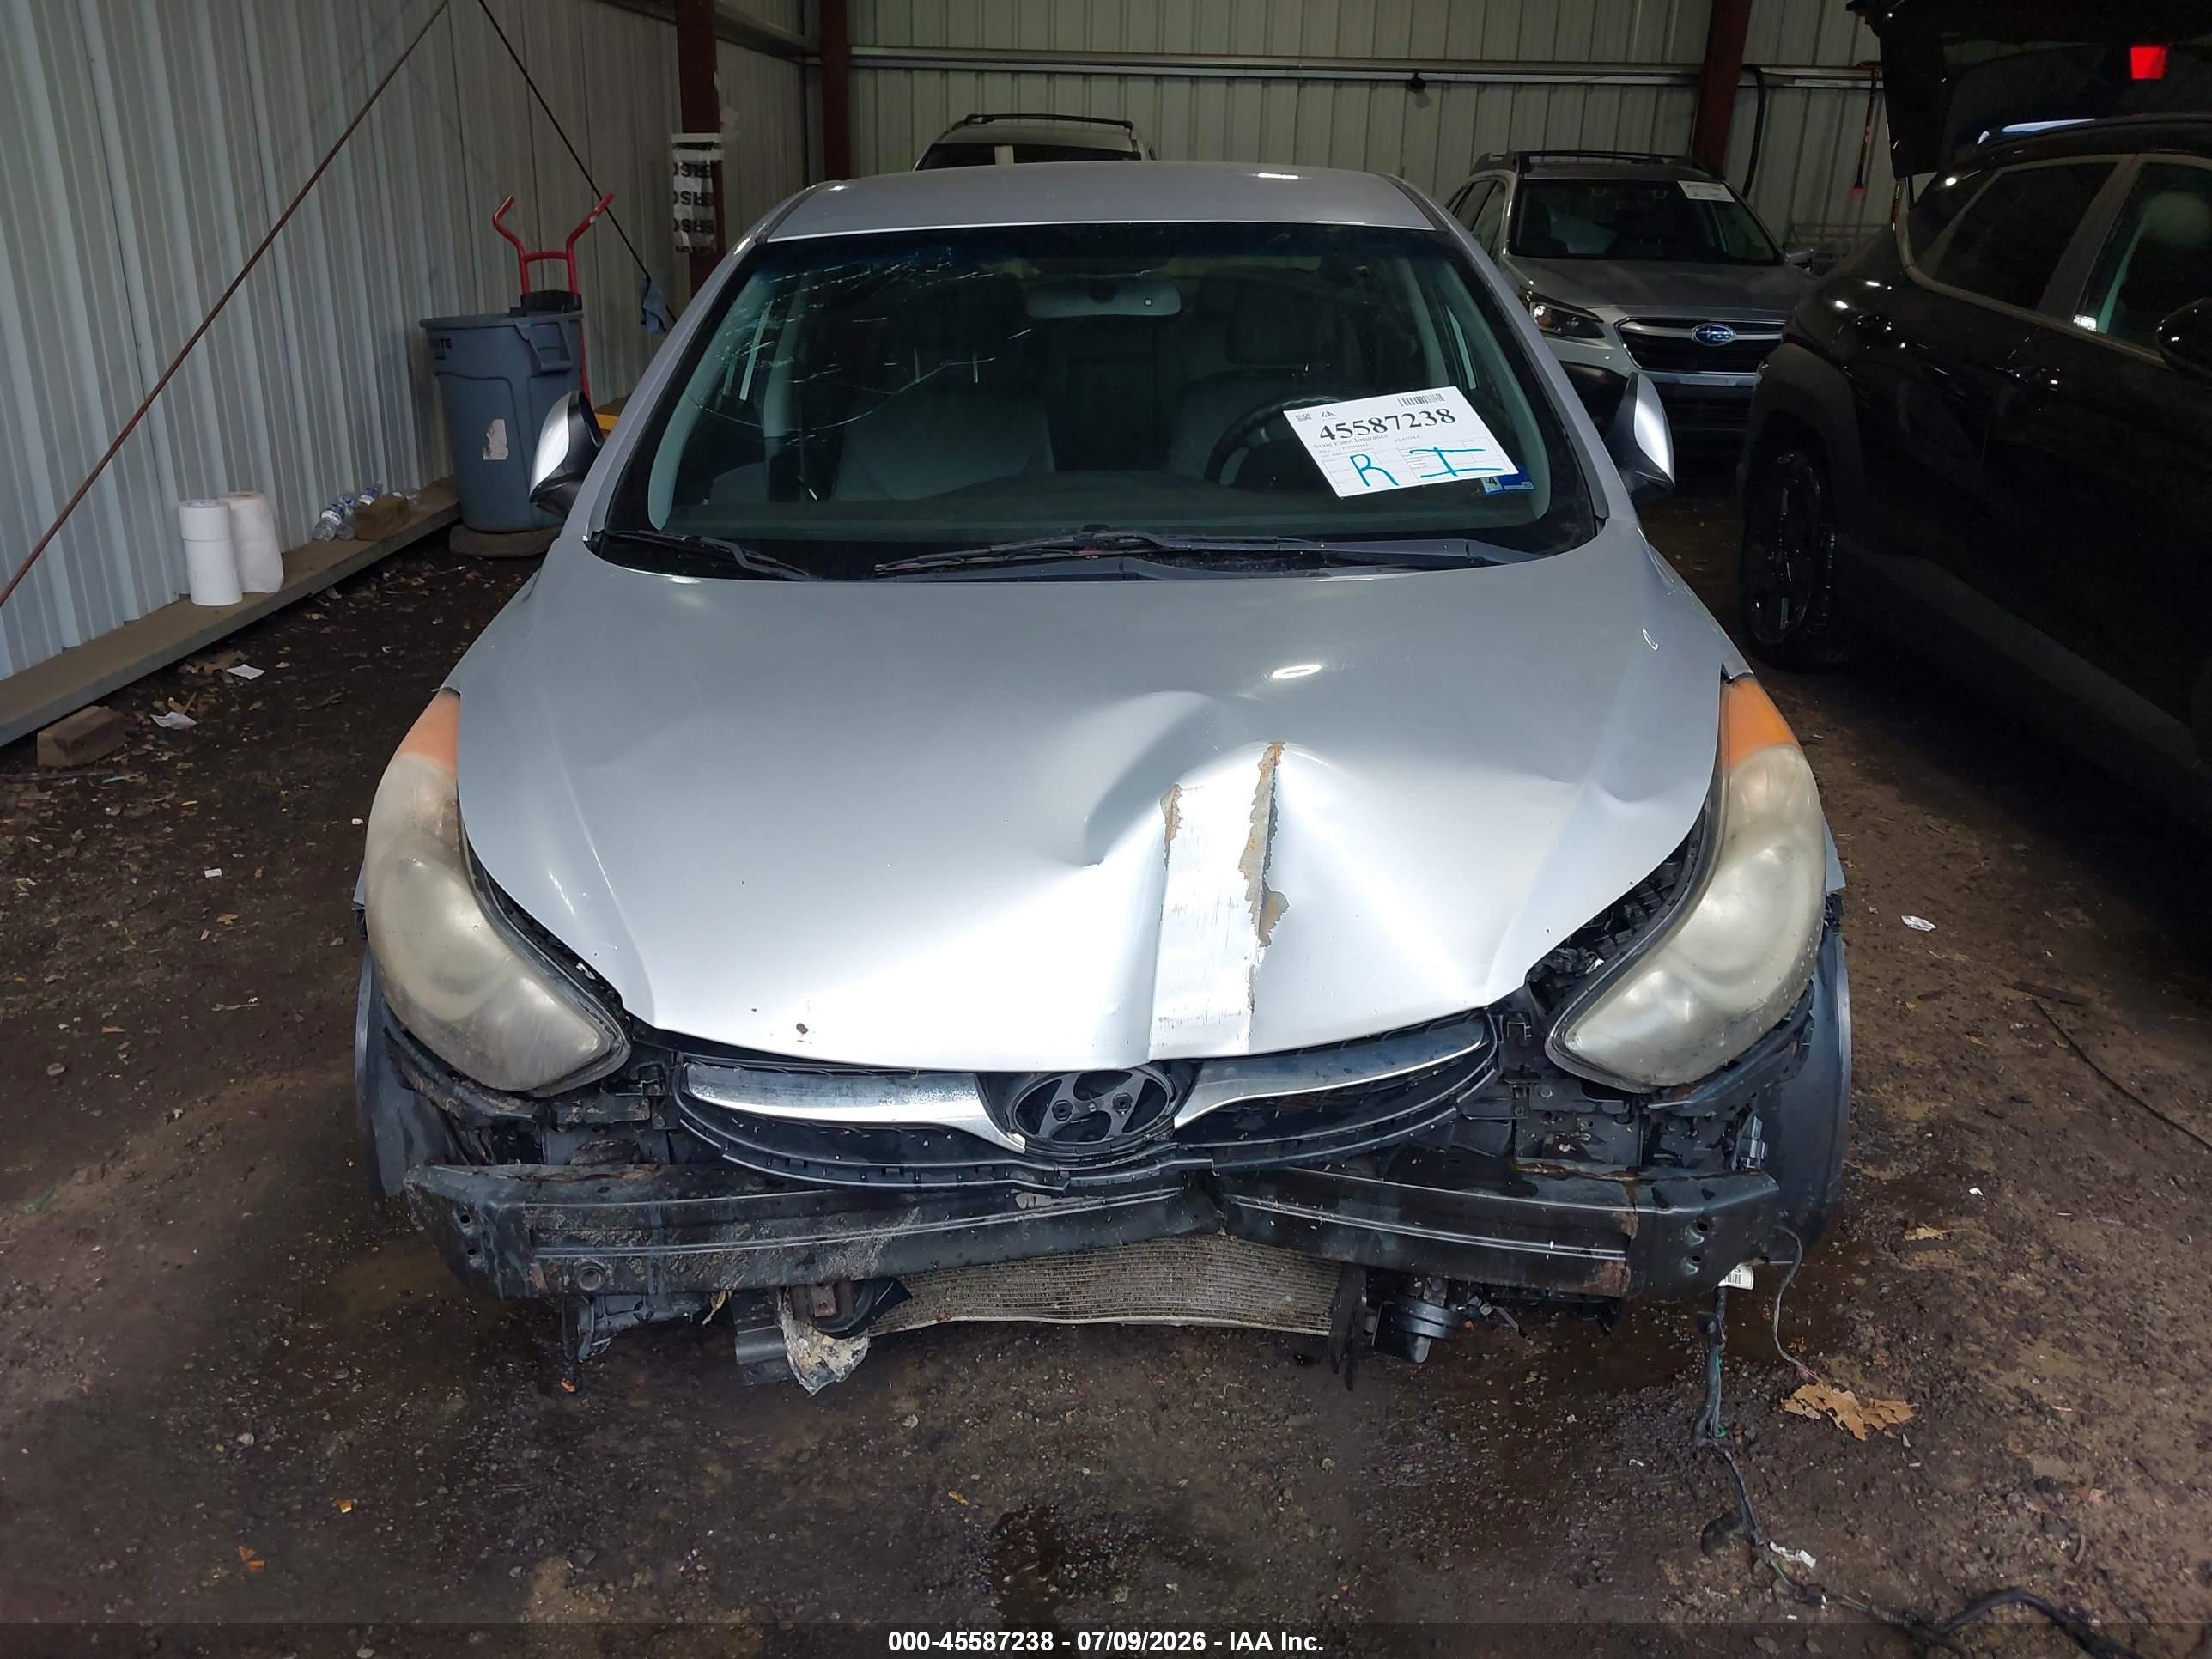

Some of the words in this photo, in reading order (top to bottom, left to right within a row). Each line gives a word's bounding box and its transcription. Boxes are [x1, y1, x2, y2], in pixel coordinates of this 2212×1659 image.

[1320, 408, 1456, 440] 45587238
[1354, 434, 1389, 444] Insurance
[1349, 453, 1400, 487] R
